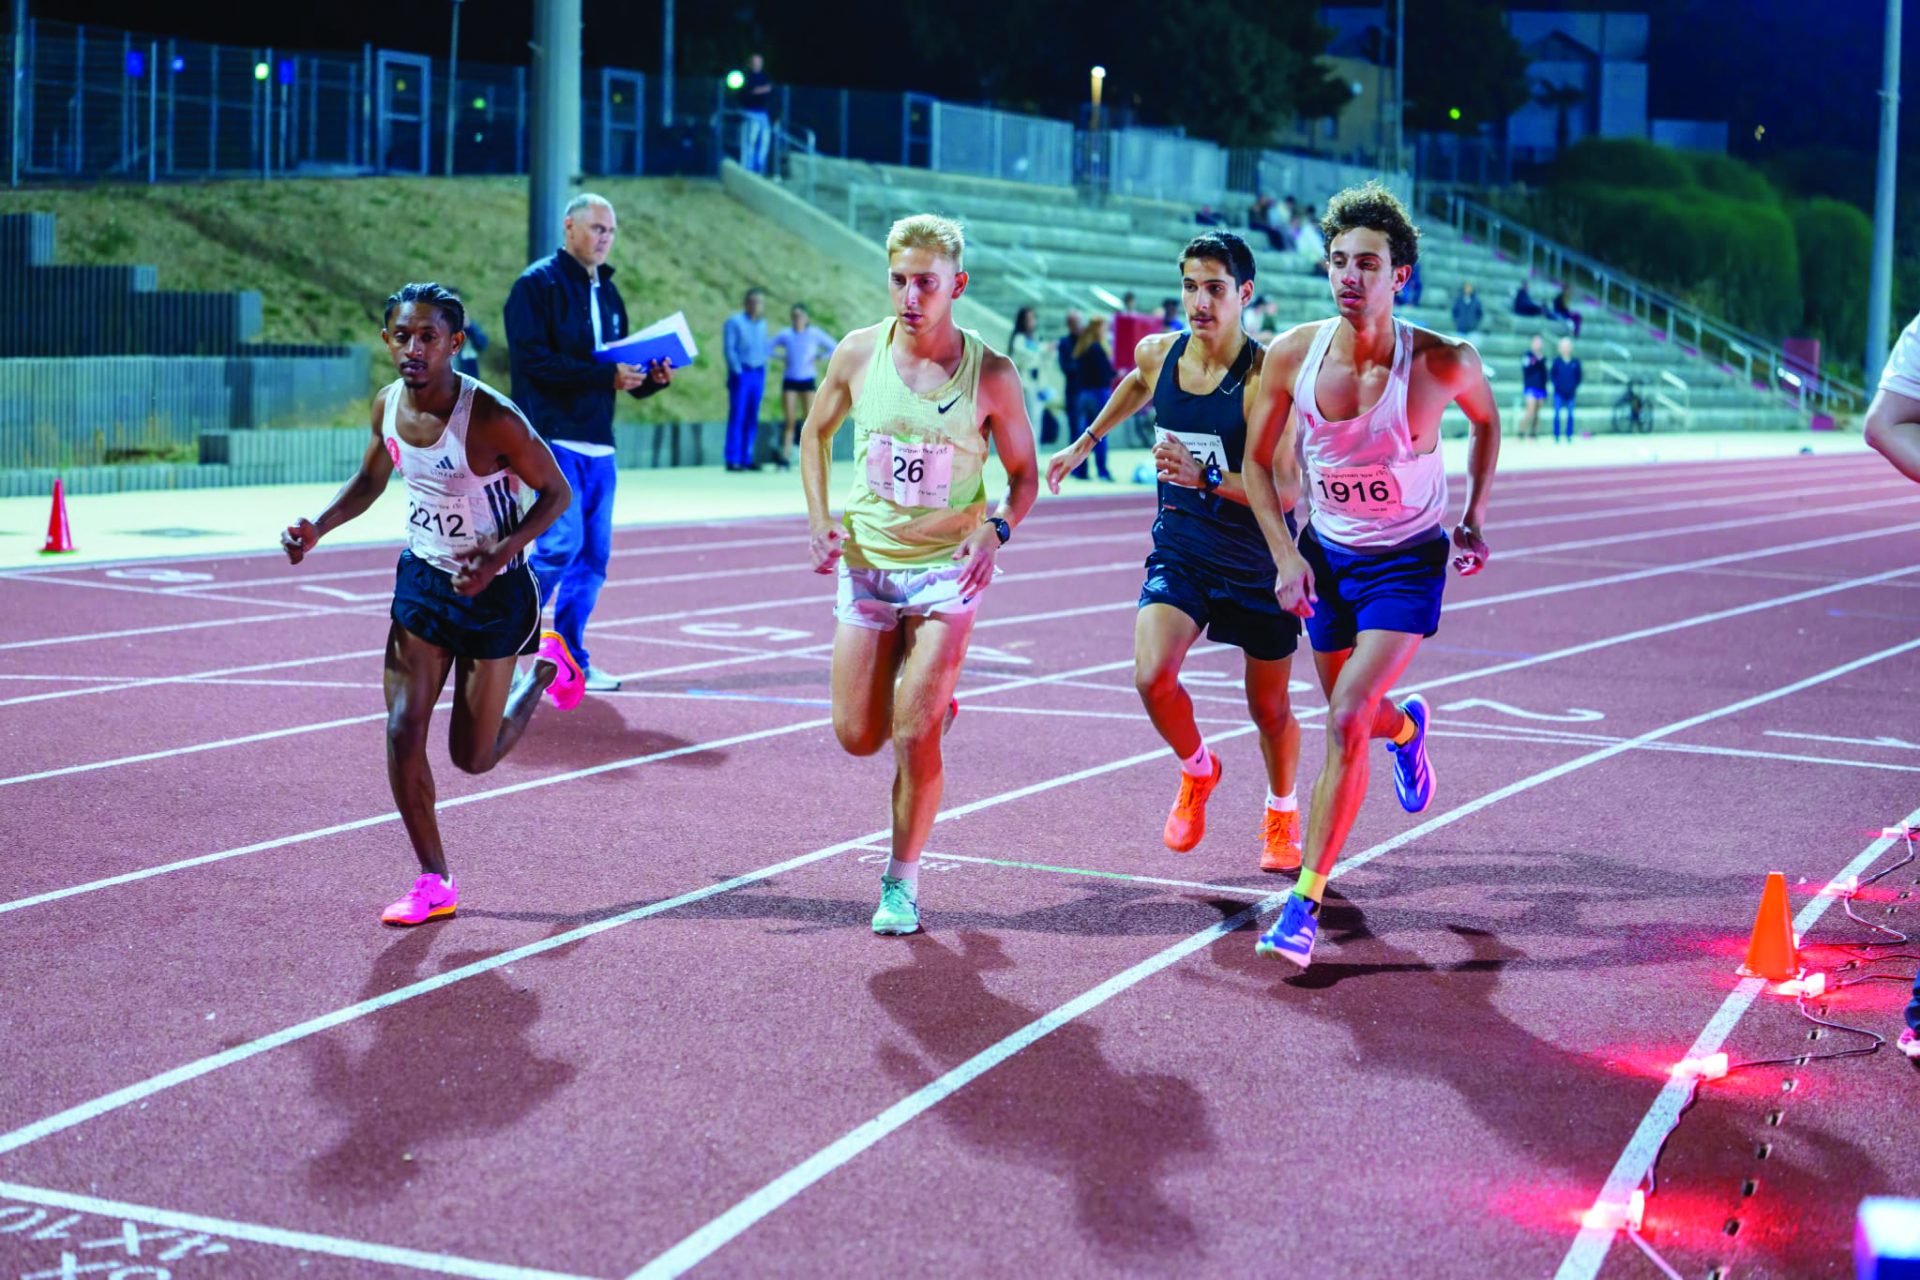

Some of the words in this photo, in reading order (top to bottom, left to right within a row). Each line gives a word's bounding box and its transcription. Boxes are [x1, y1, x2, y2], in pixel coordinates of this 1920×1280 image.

[893, 455, 924, 484] 26
[1317, 480, 1389, 503] 1916
[410, 501, 467, 538] 2212
